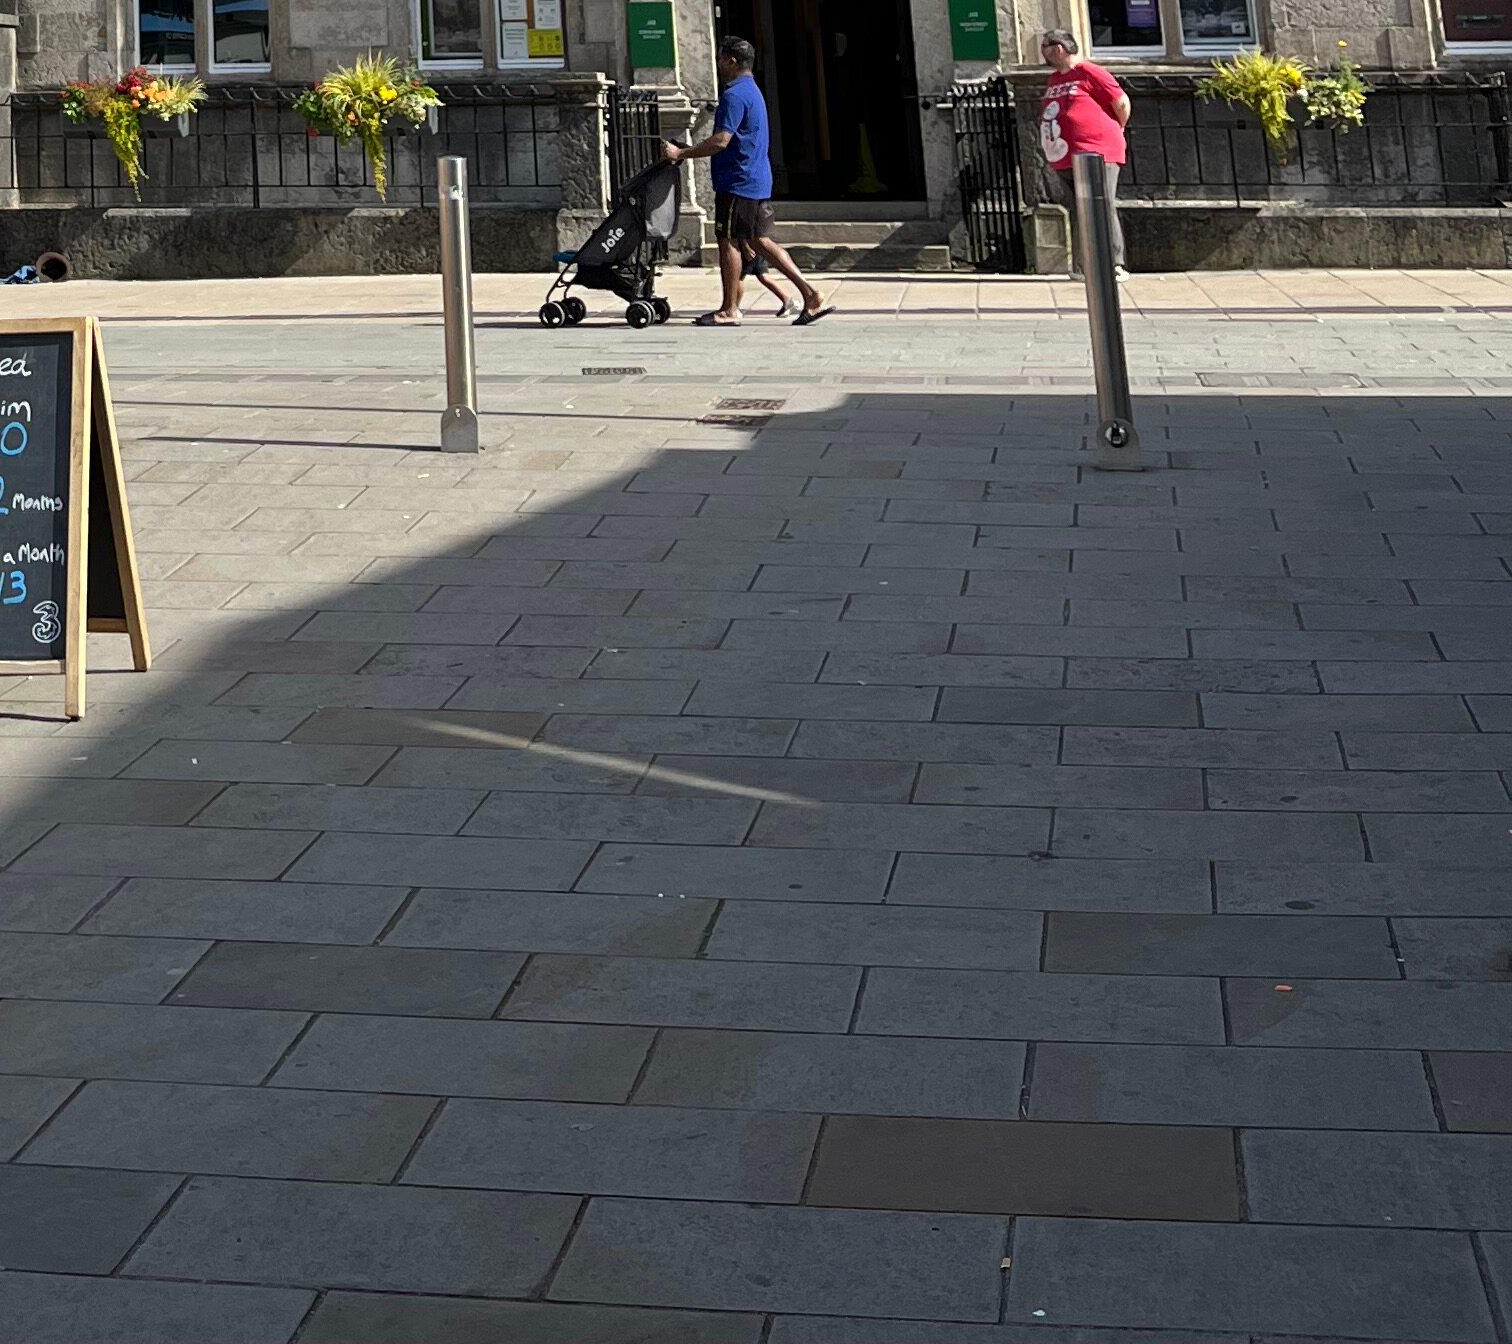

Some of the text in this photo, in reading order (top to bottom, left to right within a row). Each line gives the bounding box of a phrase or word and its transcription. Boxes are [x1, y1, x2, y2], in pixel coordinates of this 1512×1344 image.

[601, 228, 625, 253] Joie
[3, 552, 16, 565] a
[18, 542, 65, 566] Month
[31, 600, 62, 643] 3
